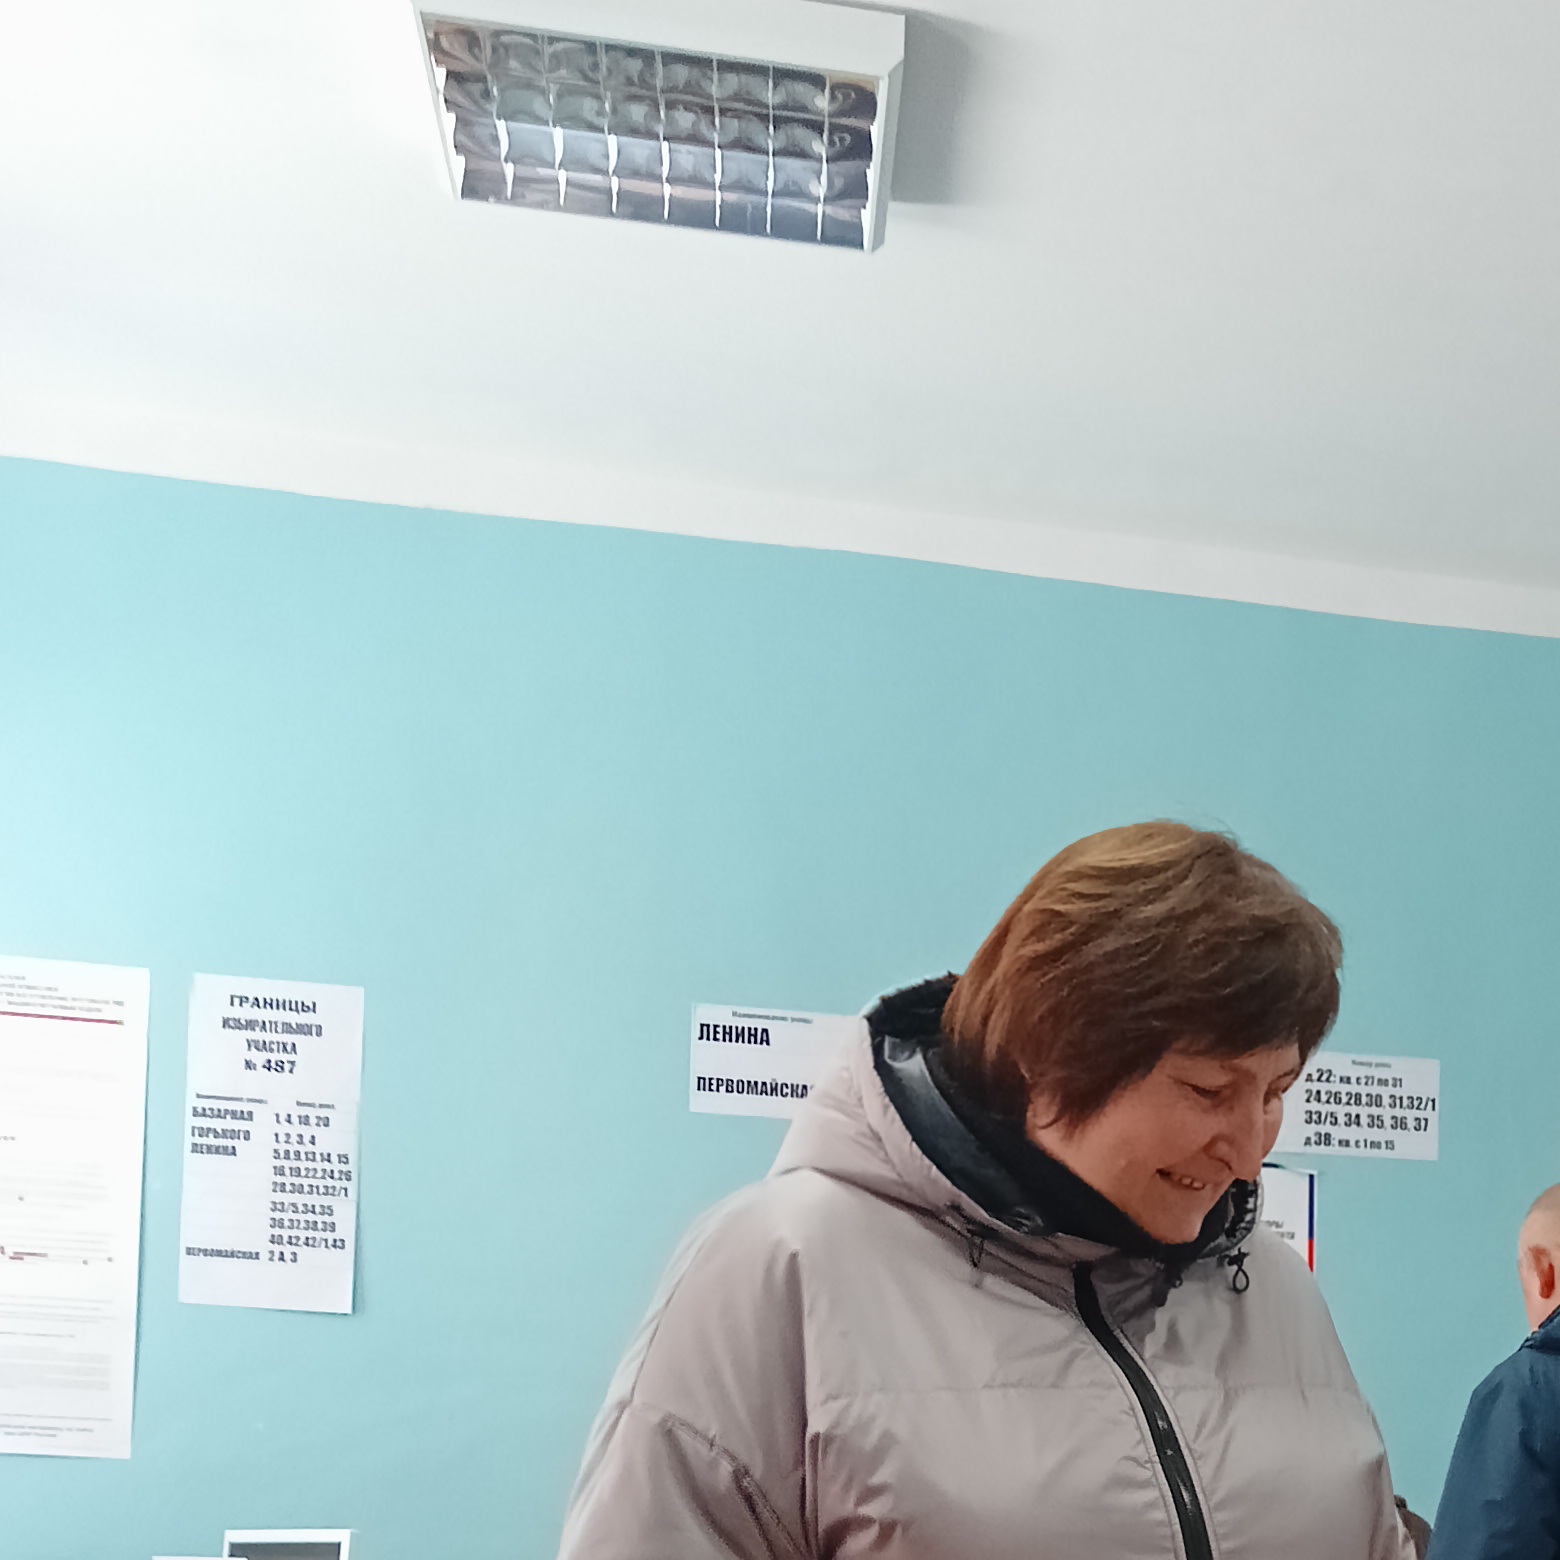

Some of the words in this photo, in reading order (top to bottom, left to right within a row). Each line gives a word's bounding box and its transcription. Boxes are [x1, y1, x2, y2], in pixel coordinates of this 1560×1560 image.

[229, 994, 317, 1015] ГРАНИЦЫ
[222, 1016, 322, 1037] ИЗБИРАТЕЛЬНОГО
[698, 1022, 771, 1047] ЛЕНИНА
[246, 1038, 298, 1055] УЧАСТКА
[244, 1058, 257, 1071] №
[261, 1059, 296, 1074] 487
[696, 1075, 814, 1100] ПЕРВОМАЙСКА
[1356, 1076, 1362, 1086] с
[1364, 1075, 1375, 1086] 27
[1377, 1077, 1389, 1088] по
[1391, 1077, 1403, 1088] 31
[192, 1106, 254, 1121] БАЗАРНАЯ
[1413, 1117, 1429, 1132] 37
[191, 1126, 250, 1141] ГОРЬКОГО
[308, 1134, 316, 1146] 4
[1355, 1139, 1361, 1149] с
[1363, 1139, 1368, 1149] 1
[1370, 1140, 1382, 1150] по
[1384, 1140, 1395, 1150] 15
